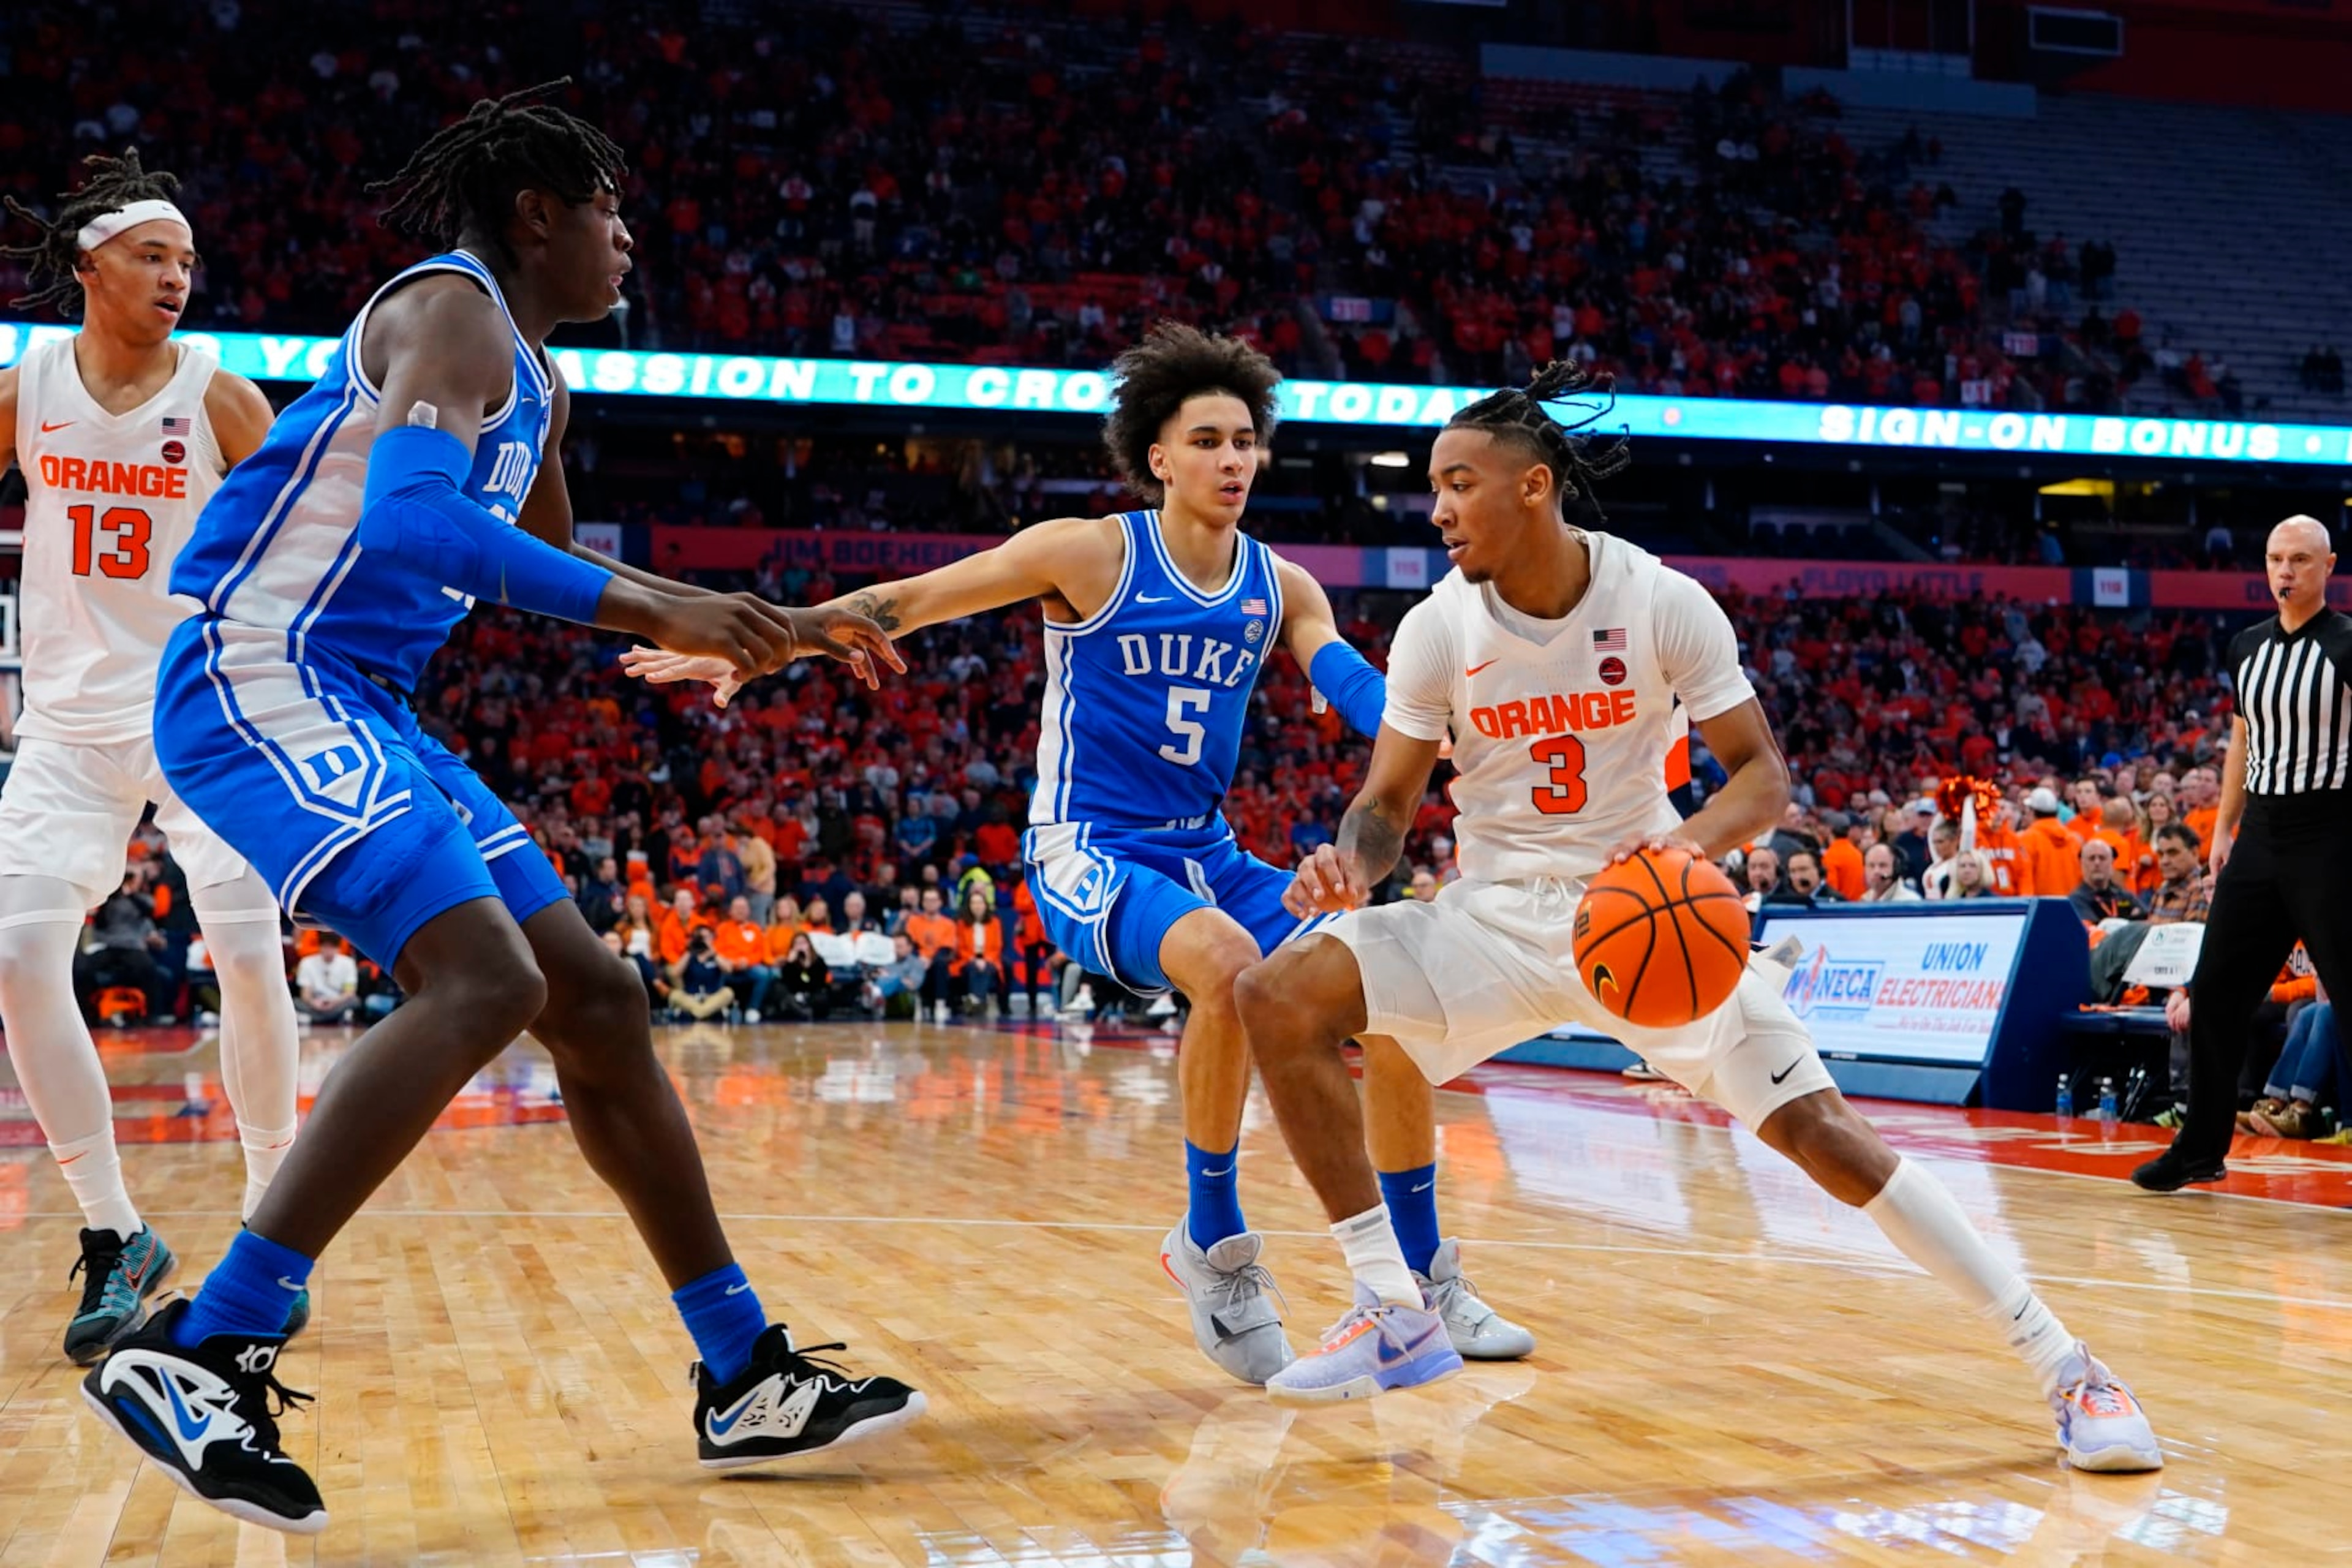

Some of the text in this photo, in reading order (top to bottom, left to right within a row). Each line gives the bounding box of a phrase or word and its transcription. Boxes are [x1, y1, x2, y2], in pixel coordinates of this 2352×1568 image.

[555, 350, 816, 400] ASSION
[848, 361, 936, 405] TO
[965, 367, 1107, 411] CRO
[1292, 382, 1493, 424] TODA
[1819, 404, 2068, 451] SIGN-ON
[2090, 417, 2280, 461] BONUS
[39, 454, 188, 499] ORANGE
[67, 504, 152, 580] 13
[1116, 633, 1256, 688] DUKE
[1158, 684, 1212, 767] 5
[1469, 689, 1637, 740] ORANGE
[1529, 734, 1588, 815] 3
[1921, 942, 1989, 971] UNION
